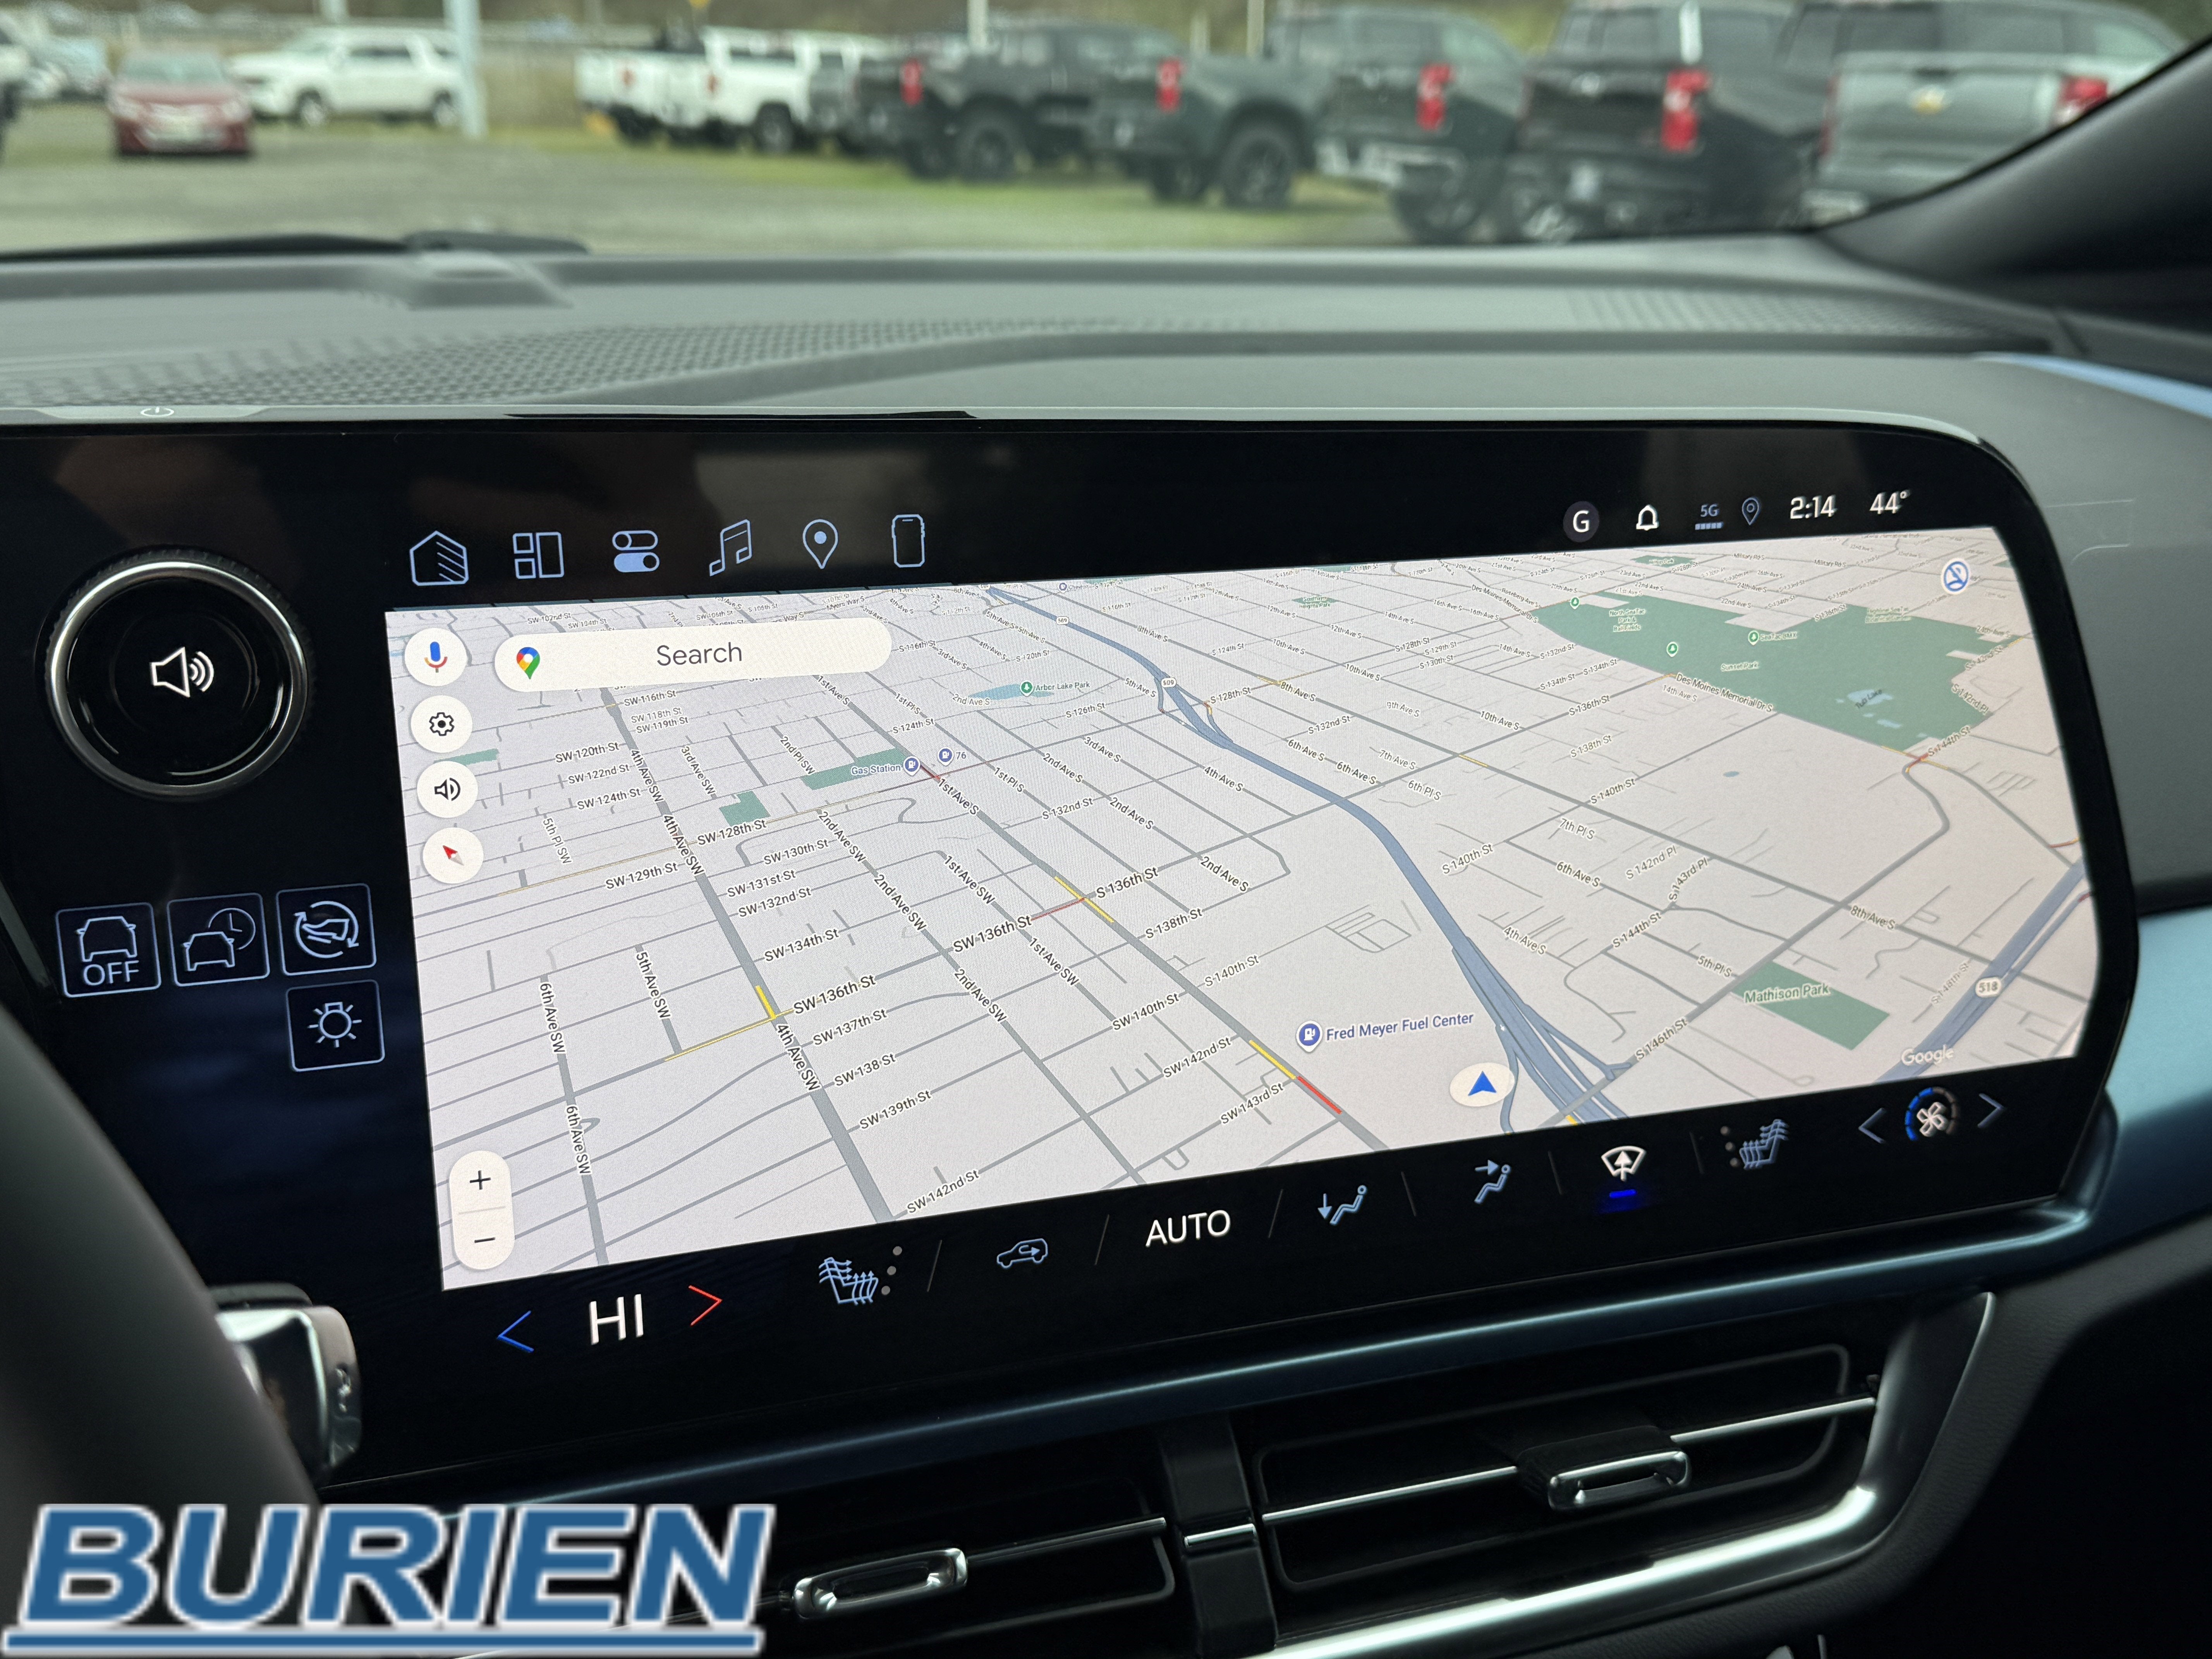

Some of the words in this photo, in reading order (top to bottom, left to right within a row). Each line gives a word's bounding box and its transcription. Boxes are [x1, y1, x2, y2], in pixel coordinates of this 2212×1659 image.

[1700, 504, 1719, 517] 5G
[1790, 495, 1836, 519] 2:14
[1870, 490, 1910, 514] 44°
[1572, 510, 1590, 533] G
[657, 642, 742, 666] Search
[624, 698, 639, 706] SW
[642, 694, 665, 703] 116th
[1218, 691, 1240, 702] 128th
[1241, 687, 1250, 696] St
[1280, 682, 1293, 692] 8th
[1293, 687, 1309, 699] Ave
[1676, 673, 1691, 685] Des
[1692, 679, 1719, 695] Moines
[1721, 690, 1756, 708] Memorial
[1756, 701, 1766, 710] Dr
[1765, 704, 1772, 712] S
[1569, 708, 1575, 716] S
[1577, 700, 1599, 713] 136th
[1601, 696, 1609, 704] St
[653, 720, 677, 730] 119th
[680, 716, 689, 725] St
[1480, 711, 1498, 723] 10th
[1498, 717, 1513, 728] Ave
[555, 753, 572, 762] SW
[576, 747, 605, 758] 120th
[608, 742, 619, 751] St
[1928, 747, 1935, 756] S
[1936, 733, 1960, 750] 144th
[1960, 726, 1971, 735] St
[568, 775, 584, 784] SW
[587, 769, 617, 780] 122nd
[619, 764, 630, 773] St
[631, 750, 644, 766] 4th
[639, 766, 653, 785] Ave
[649, 785, 663, 803] SW
[682, 746, 694, 764] 3rd
[691, 764, 704, 779] Ave
[702, 779, 715, 795] SW
[870, 764, 900, 773] Station
[577, 800, 594, 809] SW
[598, 793, 627, 804] 124th
[630, 788, 641, 797] St
[1408, 781, 1424, 793] 6th
[1424, 787, 1434, 797] Pl
[1434, 792, 1441, 800] S
[544, 818, 555, 835] 5th
[552, 836, 562, 847] Pl
[558, 847, 572, 864] SW
[698, 834, 716, 844] SW
[720, 825, 750, 839] 128th
[755, 821, 766, 830] St
[764, 855, 780, 865] SW
[785, 845, 814, 858] 130th
[817, 840, 828, 849] St
[1696, 857, 1707, 869] Pl
[606, 879, 625, 889] SW
[629, 868, 661, 883] 129th
[665, 862, 678, 873] St
[727, 887, 745, 897] SW
[749, 875, 781, 891] 131st
[783, 870, 796, 879] St
[945, 856, 962, 872] 1st
[959, 872, 977, 889] Ave
[977, 887, 995, 904] SW
[1096, 887, 1105, 898] S
[1108, 875, 1142, 893] 136th
[1144, 867, 1158, 879] St
[1201, 857, 1220, 874] 2nd
[1220, 870, 1240, 886] Ave
[1240, 882, 1249, 892] S
[1673, 866, 1697, 891] 143rd
[1669, 892, 1678, 900] S
[1146, 929, 1154, 938] S
[1157, 916, 1187, 934] 138th
[1190, 909, 1202, 919] St
[1850, 906, 1867, 918] 8th
[1869, 912, 1887, 926] Ave
[1886, 919, 1895, 929] S
[764, 951, 784, 962] SW
[788, 936, 823, 954] 134th
[825, 929, 839, 940] St
[954, 936, 974, 952] SW
[978, 923, 1015, 943] 136th
[1018, 915, 1031, 928] St
[1504, 927, 1521, 941] 4th
[1520, 936, 1539, 951] Ave
[1537, 945, 1546, 955] S
[82, 960, 139, 987] OFF
[1698, 956, 1714, 968] 5th
[1714, 962, 1724, 972] Pl
[1723, 969, 1732, 977] S
[540, 984, 554, 1003] 6th
[636, 951, 651, 972] 5th
[645, 976, 659, 997] Ave
[655, 999, 670, 1018] SW
[1745, 988, 1800, 1003] Mathison
[1803, 983, 1829, 995] Park
[1978, 980, 1998, 993] 518
[545, 1007, 557, 1030] Ave
[1113, 1015, 1131, 1031] SW
[1133, 1001, 1164, 1022] 140th
[1166, 993, 1179, 1005] St
[813, 1032, 833, 1045] SW
[836, 1018, 870, 1037] 137th
[873, 1009, 887, 1021] St
[1327, 1029, 1355, 1041] Fred
[1359, 1023, 1398, 1039] Meyer
[1403, 1018, 1429, 1032] Fuel
[1433, 1013, 1473, 1027] Center
[1636, 1050, 1645, 1060] S
[1646, 1027, 1675, 1053] 146th
[1674, 1018, 1688, 1031] St
[551, 1033, 565, 1053] SW
[1901, 1045, 1954, 1066] Google
[835, 1072, 854, 1086] SW
[857, 1061, 879, 1077] 138
[882, 1053, 896, 1065] St
[860, 1114, 879, 1128] SW
[882, 1099, 915, 1118] 139th
[917, 1091, 931, 1103] St
[1221, 1109, 1238, 1124] SW
[1240, 1092, 1270, 1115] 143rd
[1271, 1083, 1283, 1095] St
[907, 1198, 926, 1213] SW
[929, 1180, 963, 1203] 142nd
[965, 1171, 979, 1182] St
[1146, 1209, 1230, 1247] AUTO
[590, 1294, 643, 1345] HI
